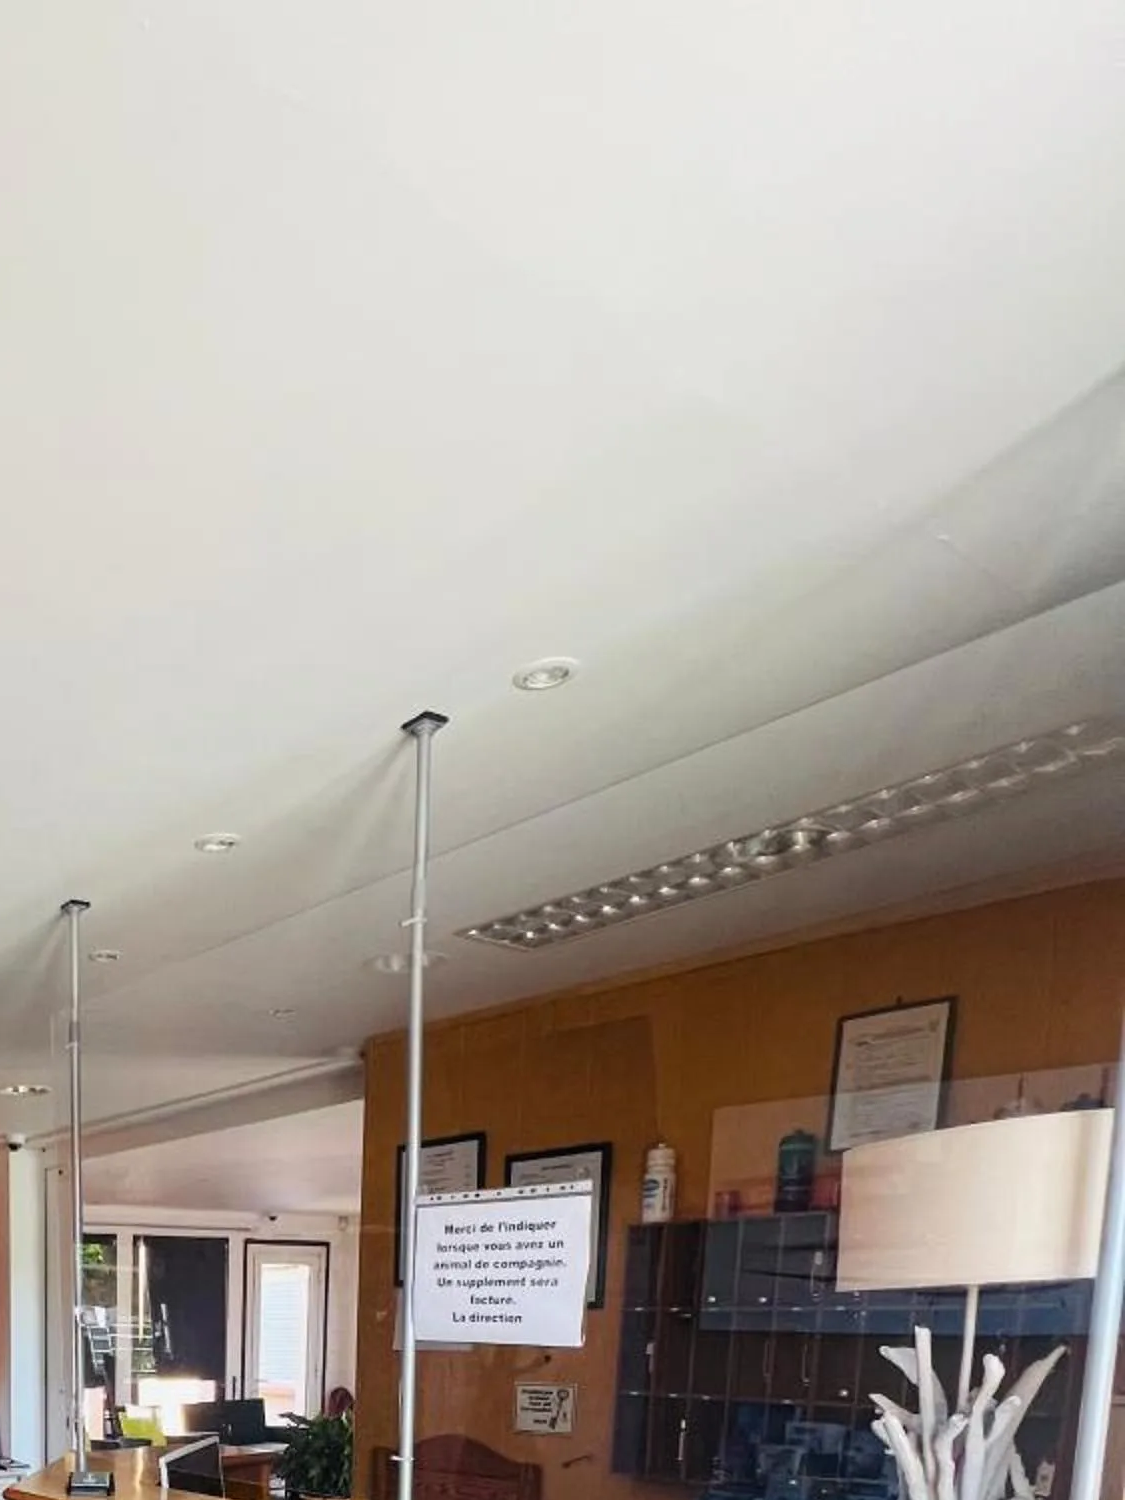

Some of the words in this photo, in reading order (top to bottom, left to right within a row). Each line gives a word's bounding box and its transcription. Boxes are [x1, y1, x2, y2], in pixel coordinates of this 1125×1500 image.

[445, 1224, 476, 1234] Merci
[480, 1222, 494, 1233] de
[436, 1243, 479, 1253] lorsque
[484, 1242, 512, 1250] vous
[515, 1240, 543, 1249] avez
[548, 1240, 564, 1249] un
[434, 1260, 471, 1270] animal
[475, 1260, 489, 1269] de
[437, 1278, 452, 1287] Un
[530, 1278, 558, 1287] sera
[452, 1312, 465, 1322] La
[469, 1312, 523, 1323] direction
